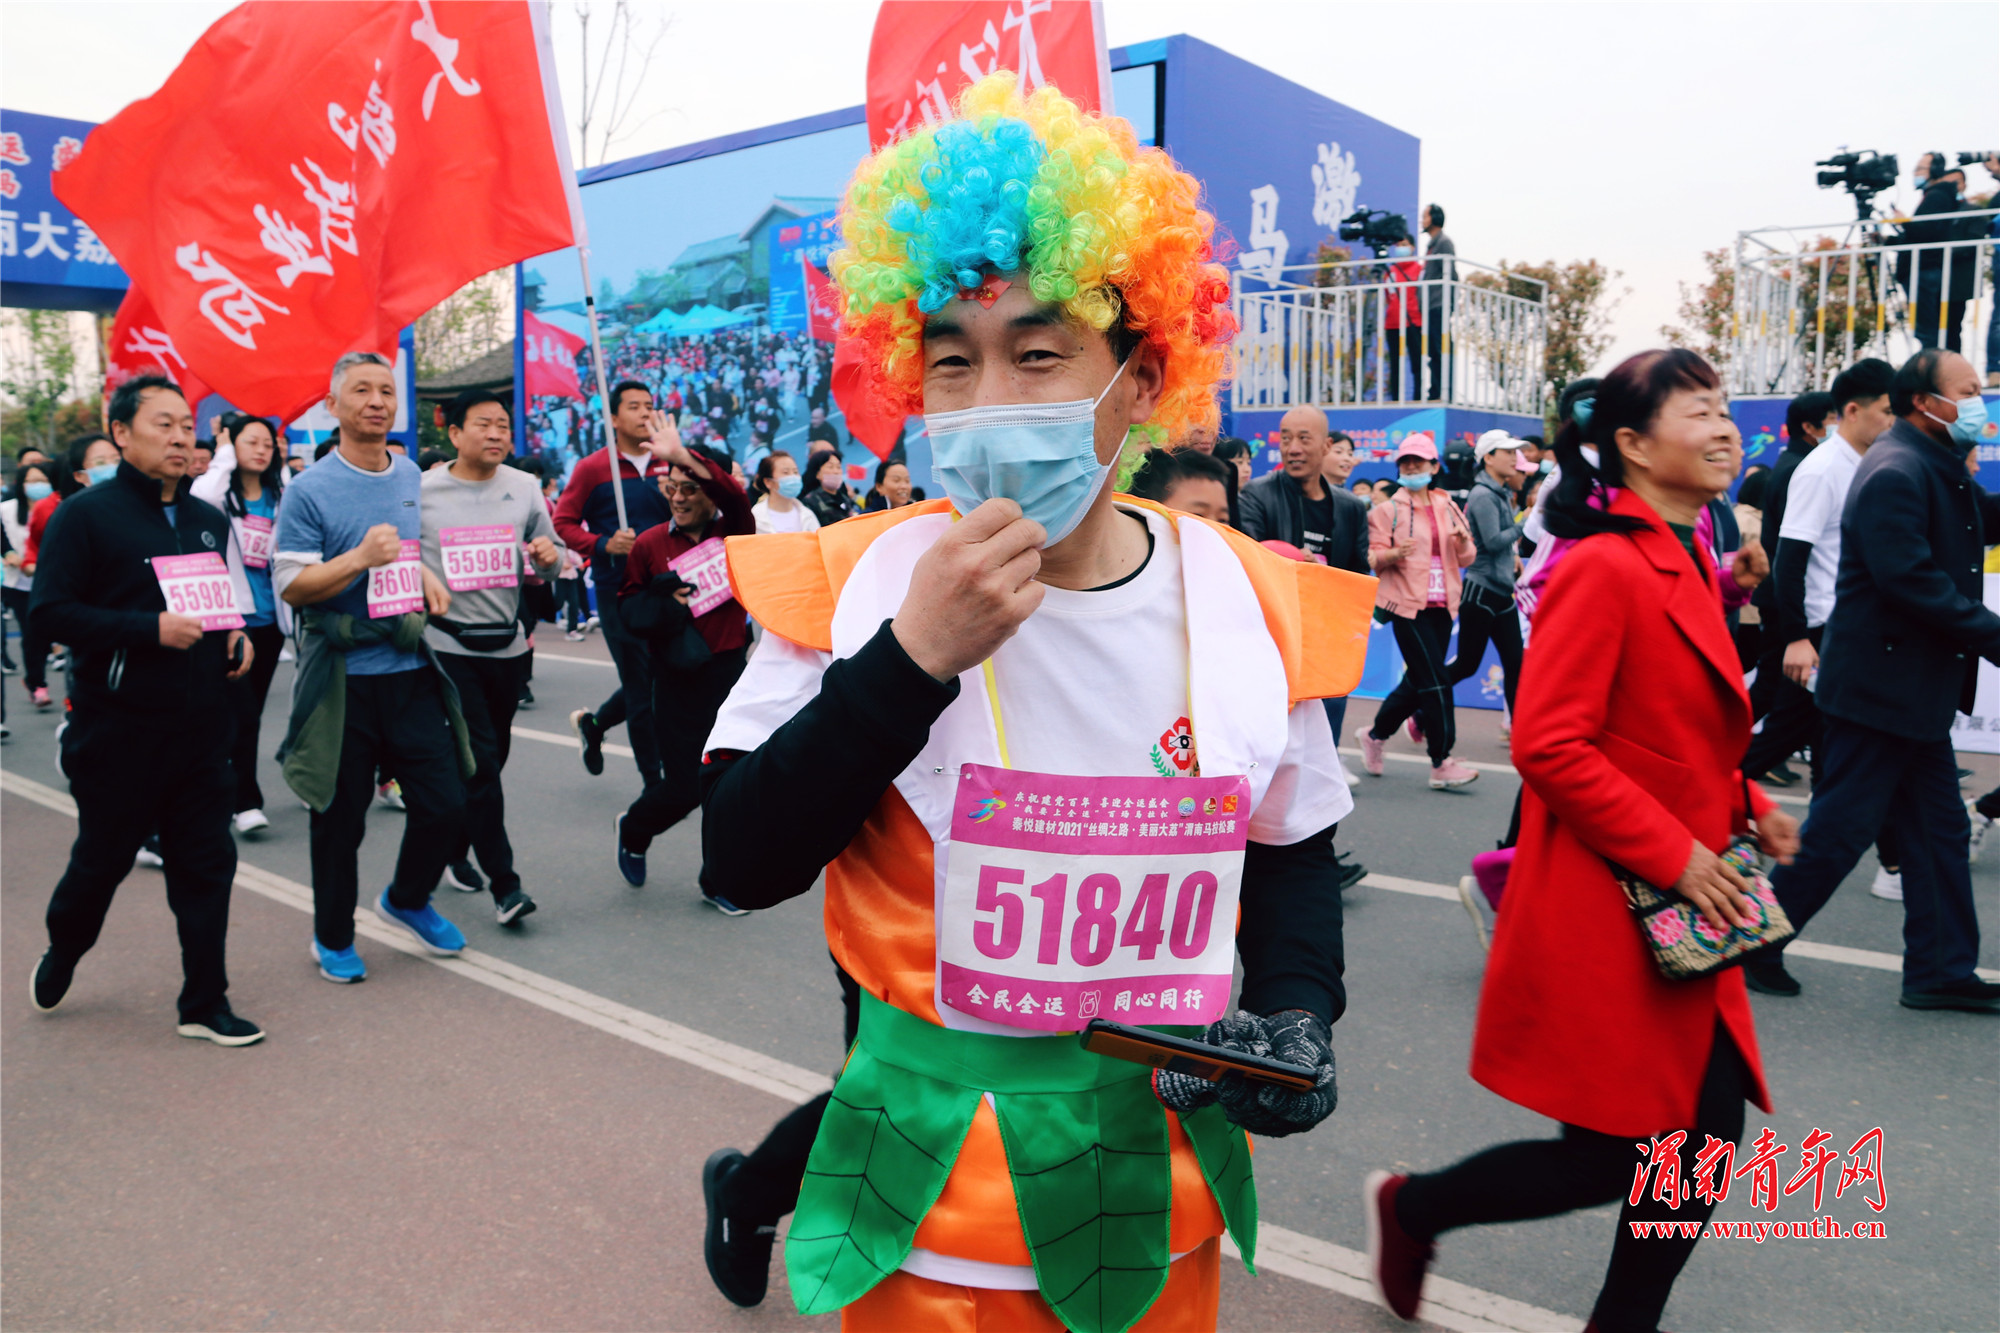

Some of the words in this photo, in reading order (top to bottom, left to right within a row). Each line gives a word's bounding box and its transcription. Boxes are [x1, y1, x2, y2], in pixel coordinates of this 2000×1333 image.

[1238, 183, 1290, 289] 马
[447, 547, 512, 575] 55984
[168, 580, 235, 613] 55982
[1014, 791, 1091, 808] 庆祝建党百年
[1100, 797, 1170, 808] 喜迎全运盛会
[973, 864, 1219, 967] 51840
[966, 984, 1066, 1016] 全民全运
[1113, 988, 1205, 1012] 同心同行
